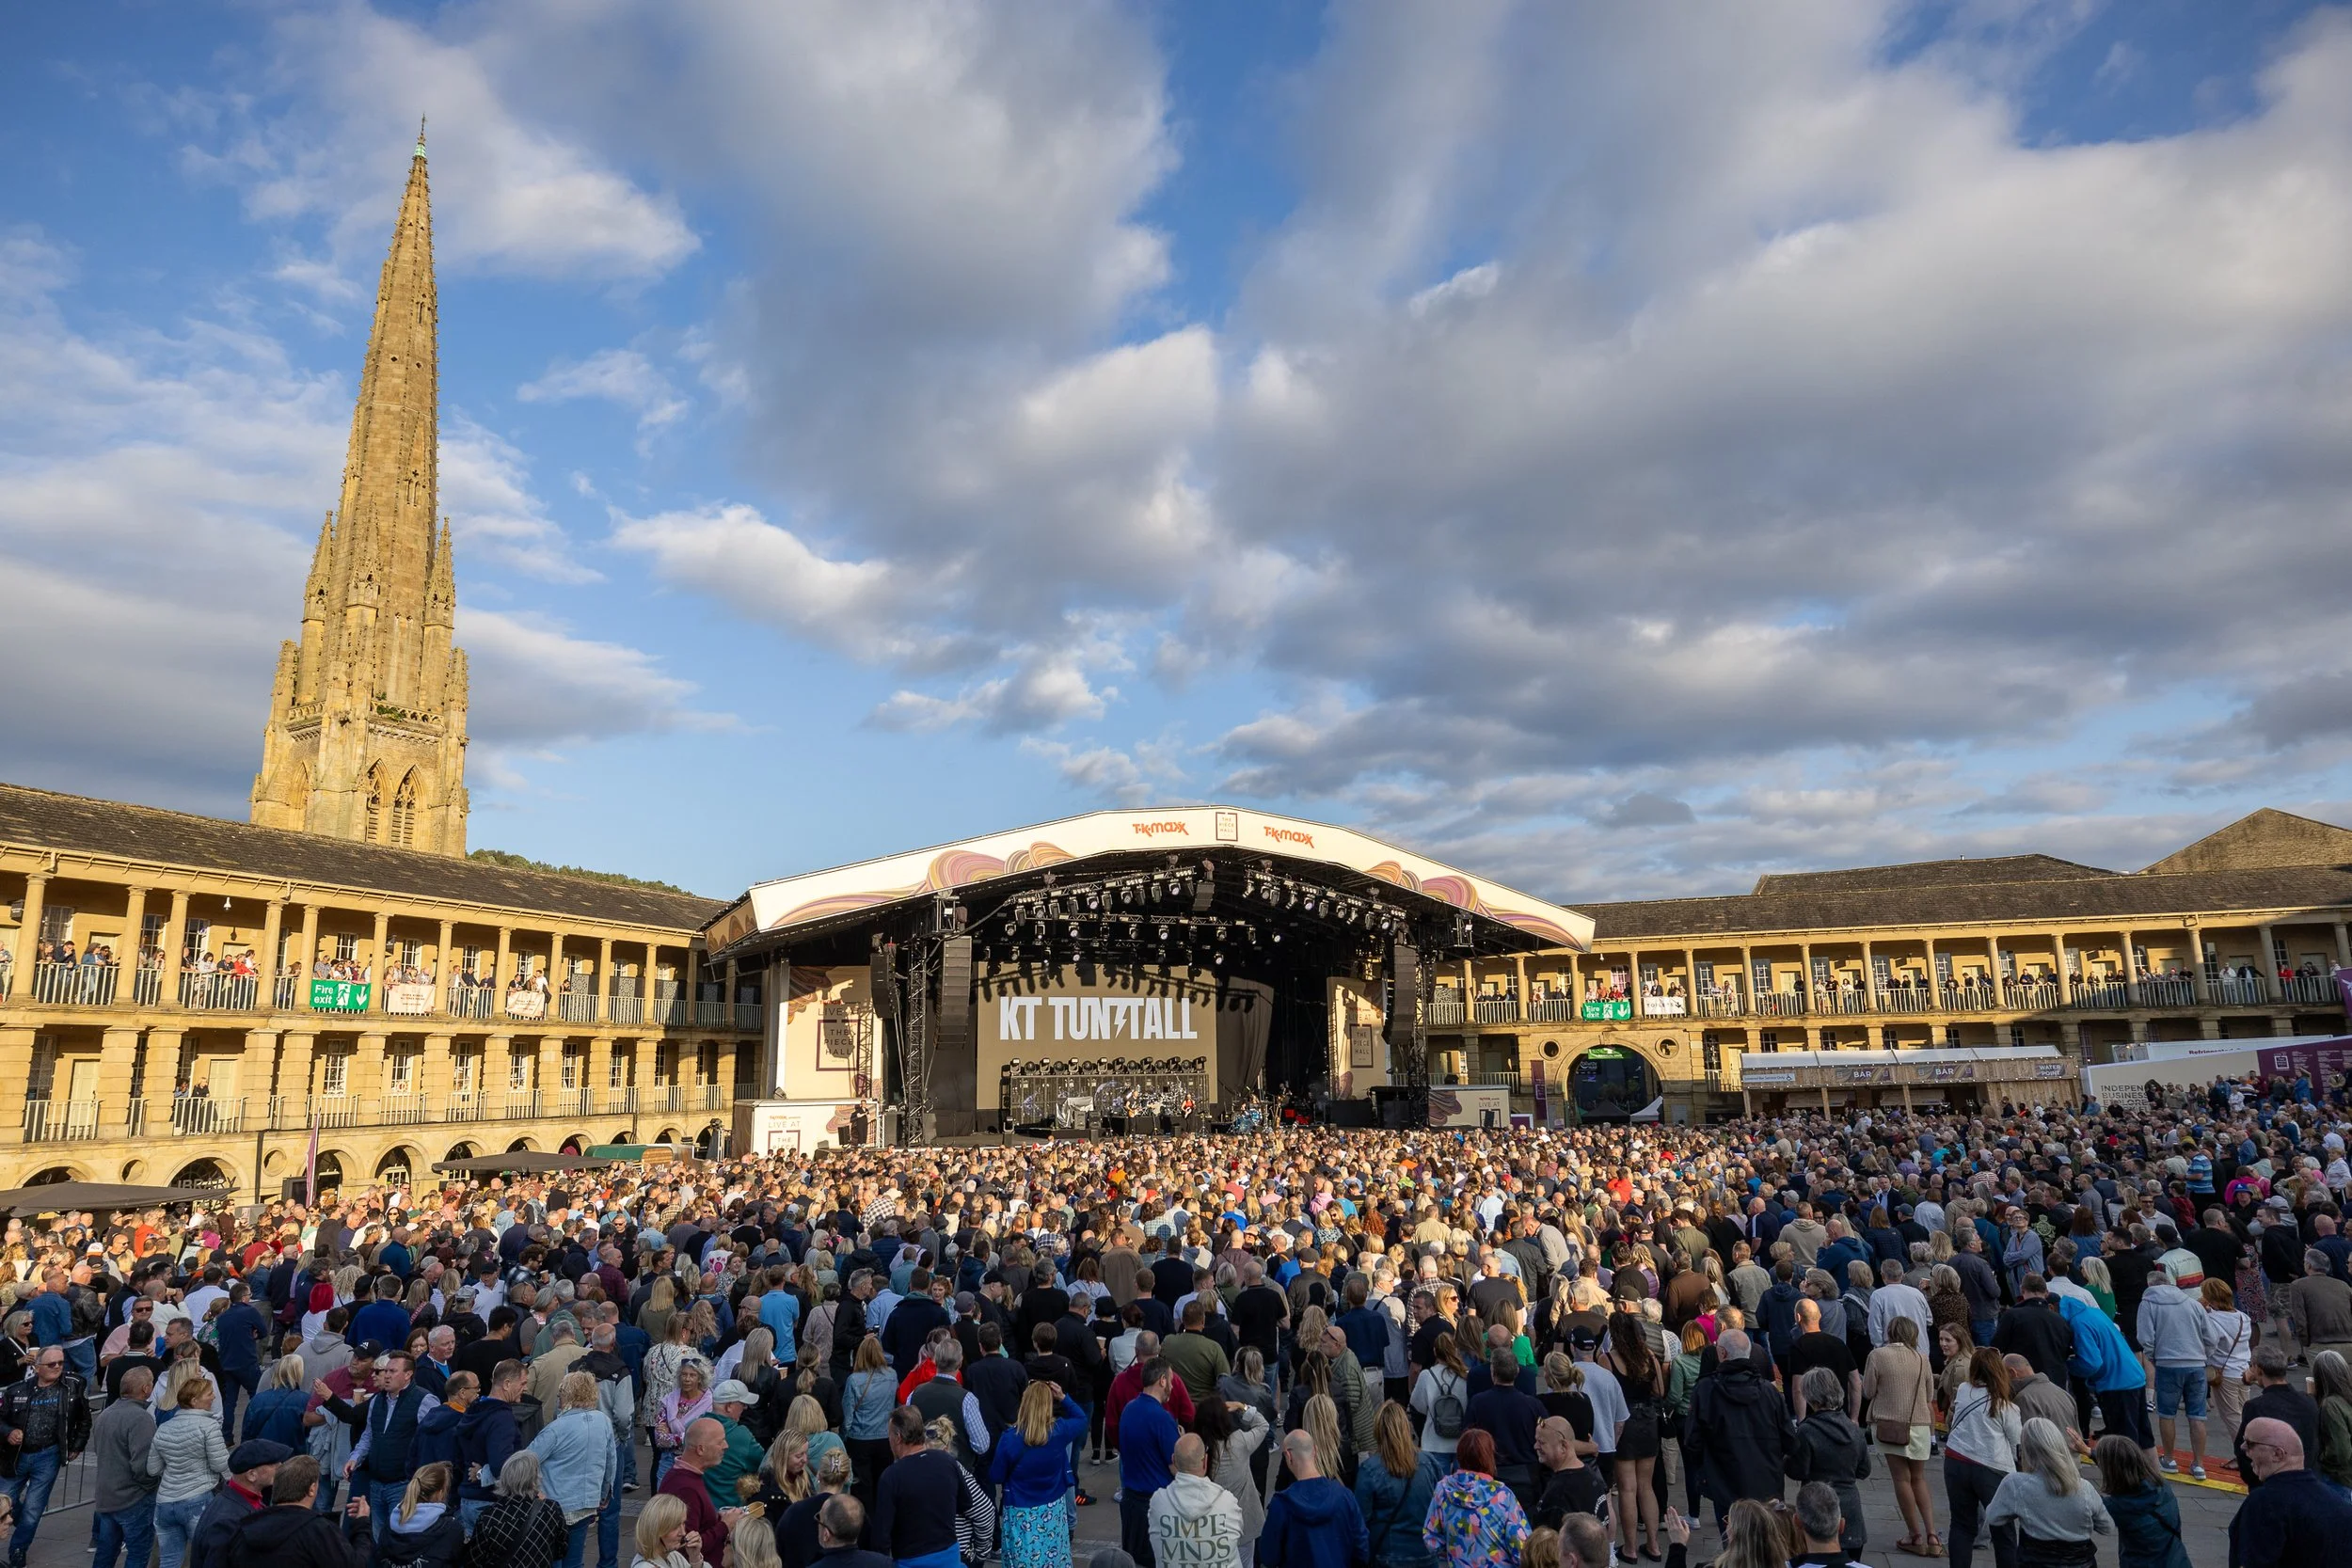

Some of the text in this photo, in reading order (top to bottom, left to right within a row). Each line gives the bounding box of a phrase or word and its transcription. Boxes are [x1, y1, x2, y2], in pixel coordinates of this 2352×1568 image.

[315, 984, 334, 994] Fire
[313, 995, 333, 1005] exit
[999, 996, 1042, 1040] KT
[1935, 1068, 1954, 1076] BAR
[1159, 1513, 1228, 1538] SIMPLE
[1161, 1536, 1231, 1561] MINDS
